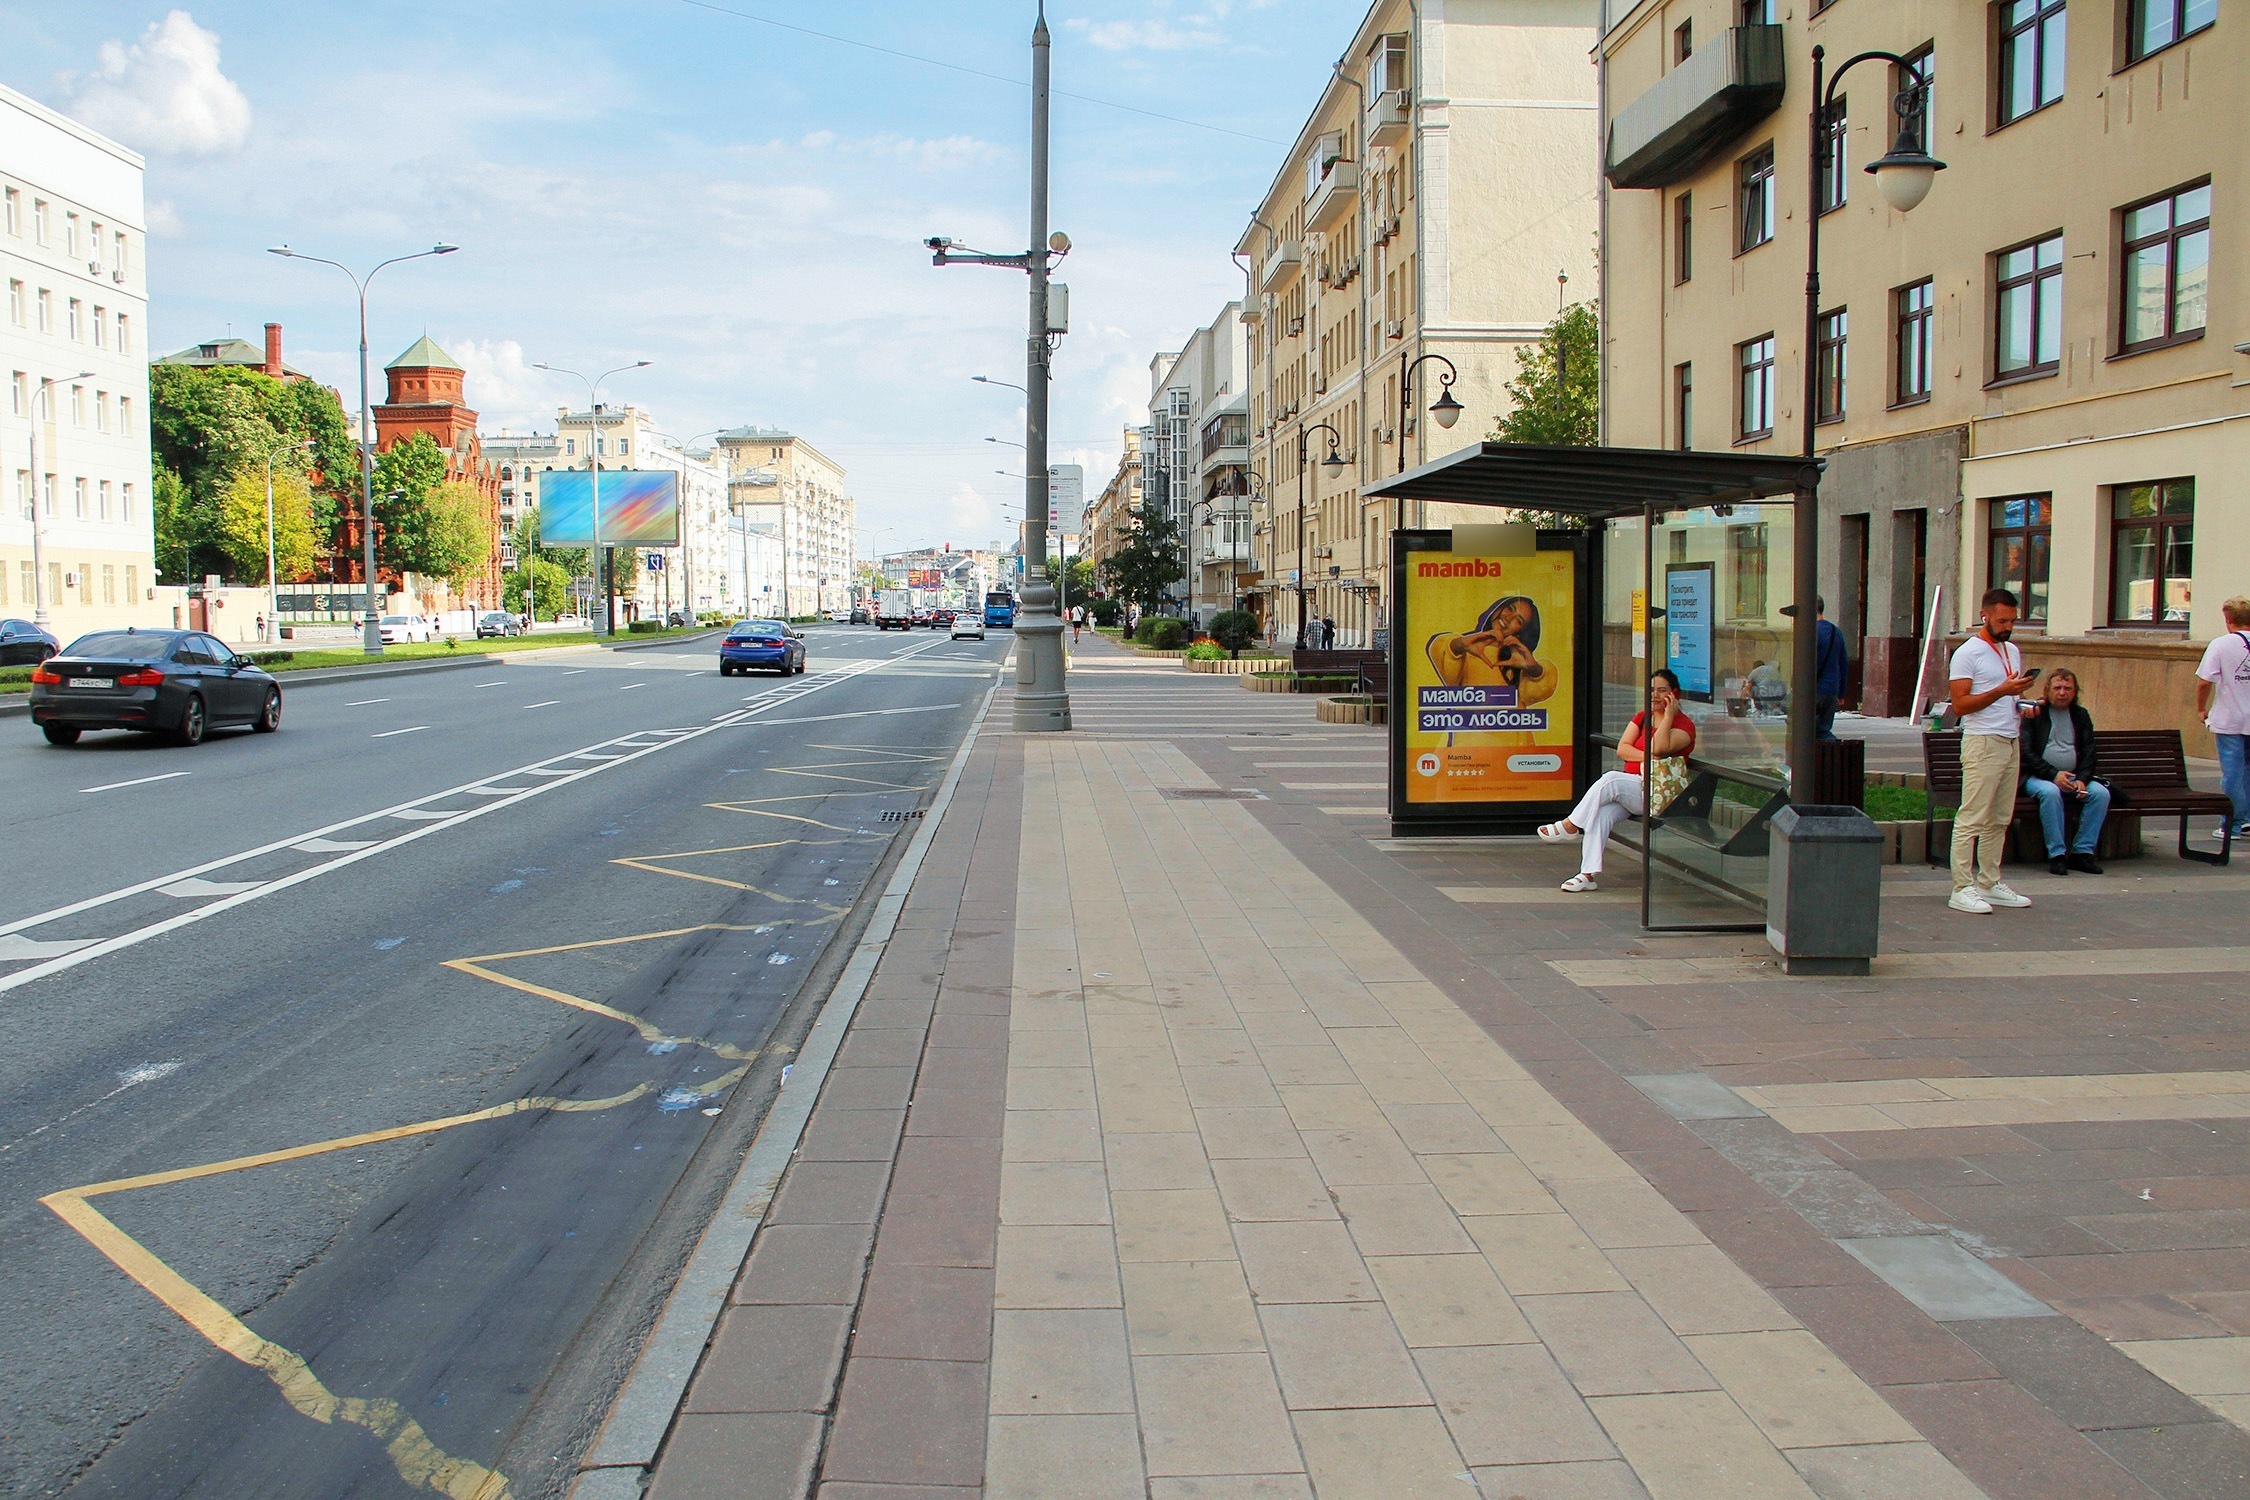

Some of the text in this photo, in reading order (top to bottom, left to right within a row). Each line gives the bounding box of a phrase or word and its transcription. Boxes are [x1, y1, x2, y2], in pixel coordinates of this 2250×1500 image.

[1418, 558, 1501, 577] mamba
[1423, 687, 1485, 703] мамба
[1423, 710, 1541, 727] это любовь
